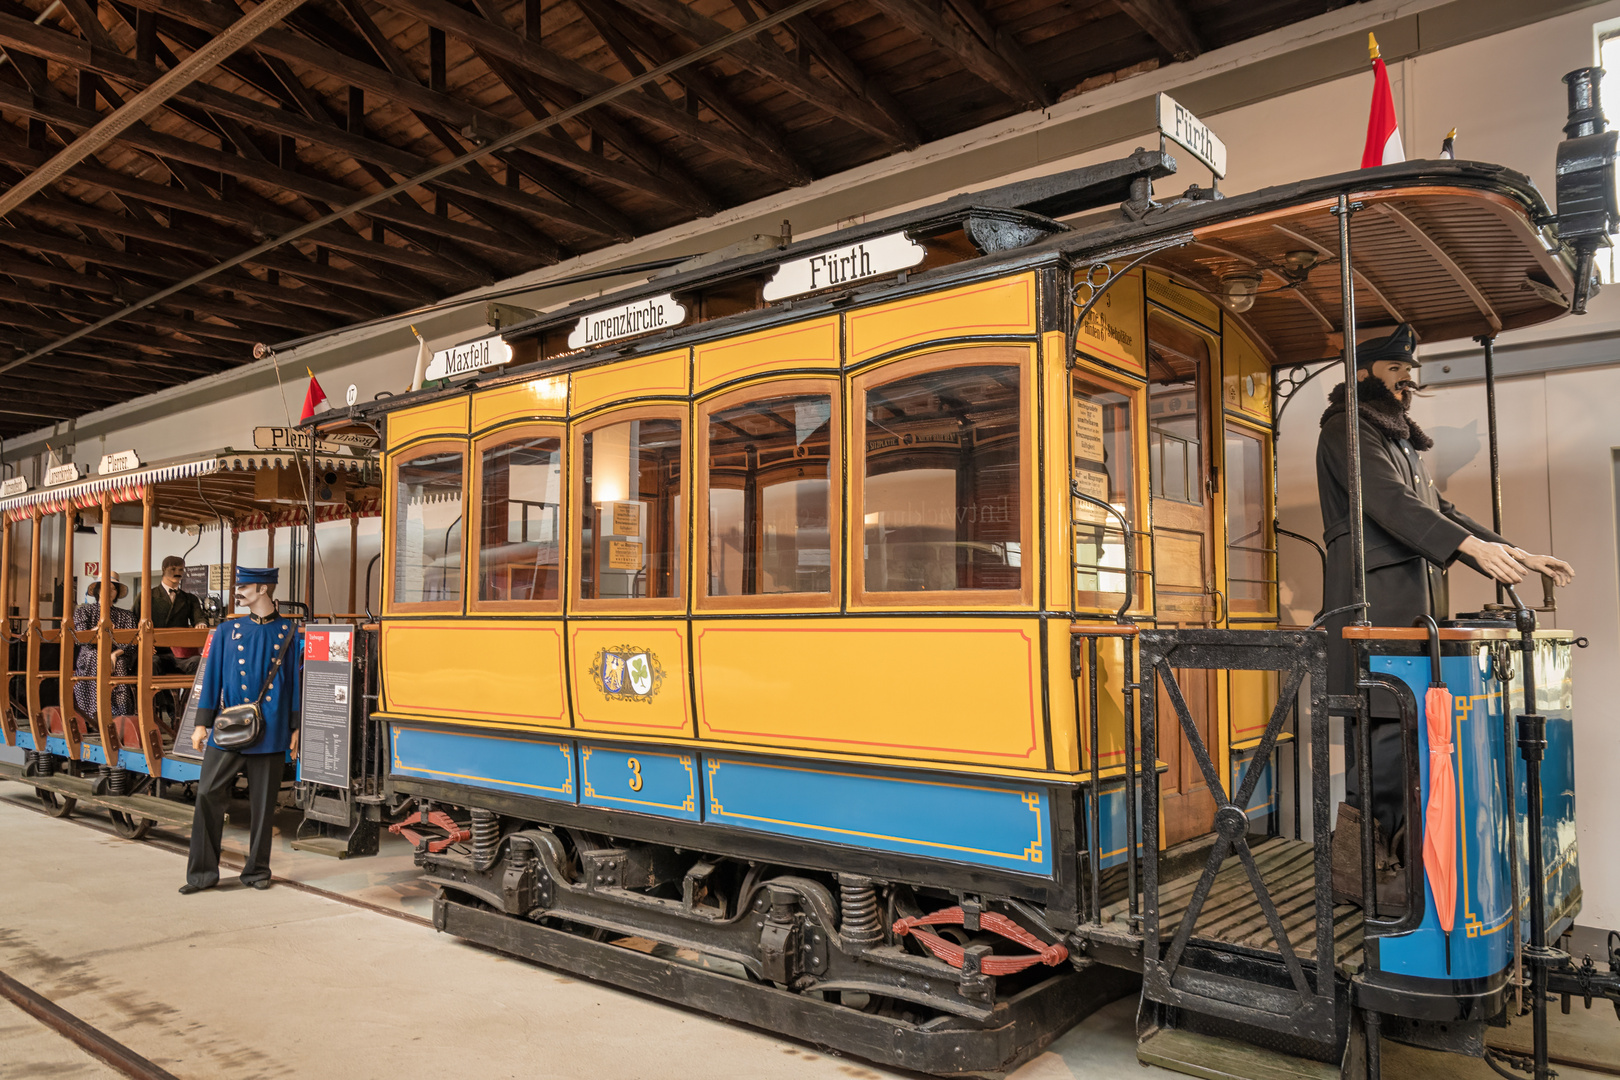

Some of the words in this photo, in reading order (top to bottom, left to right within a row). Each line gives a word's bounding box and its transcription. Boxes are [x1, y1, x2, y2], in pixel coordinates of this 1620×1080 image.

[1174, 103, 1217, 166] Fürth.
[809, 244, 877, 290] Fürth.
[1106, 292, 1111, 308] 3
[585, 300, 668, 344] Lorenzkirche.
[444, 341, 492, 375] Maxfeld.
[307, 641, 313, 654] 3
[627, 757, 643, 792] 3
